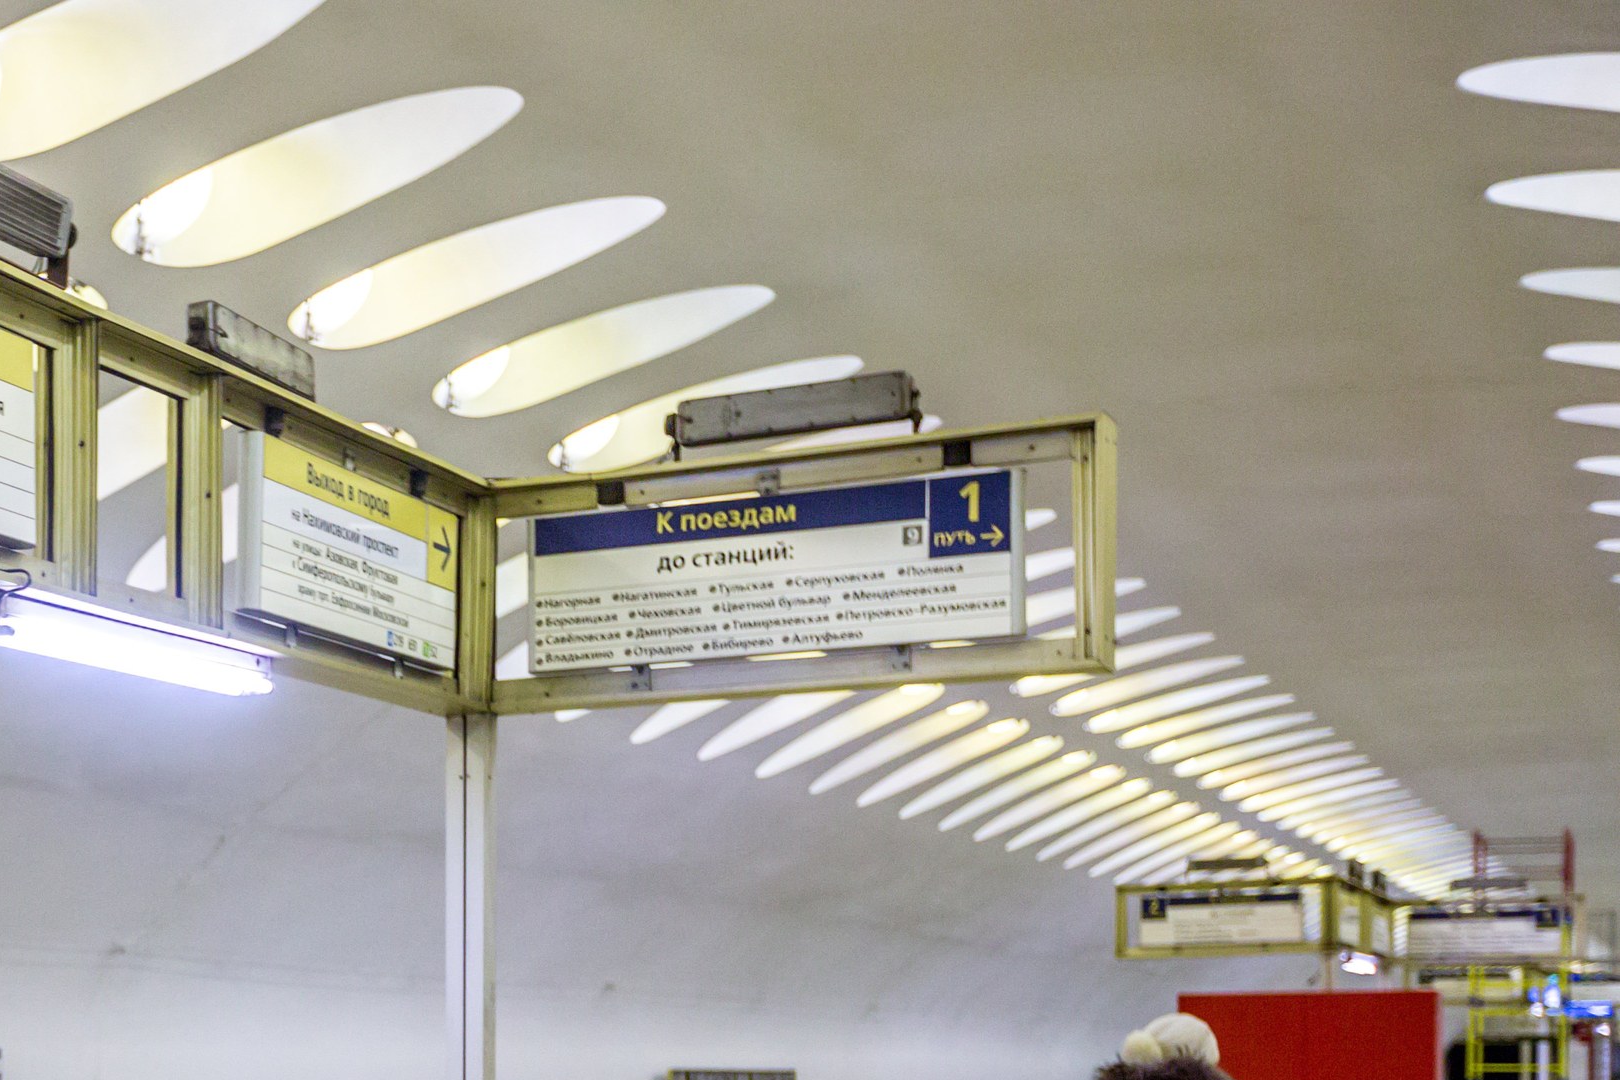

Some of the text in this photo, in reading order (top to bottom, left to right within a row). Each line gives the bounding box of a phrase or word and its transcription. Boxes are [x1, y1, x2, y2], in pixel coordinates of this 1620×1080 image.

[307, 461, 391, 520] Выход в город
[959, 480, 980, 523] 1
[656, 504, 797, 534] К поездам
[656, 541, 795, 573] до станций:
[544, 563, 964, 611] Нагорная Нагатинская Тульская Серпуховская Полянка
[545, 583, 957, 629] Боровицкая Чеховская Цветной бульвар Менделеевская
[545, 628, 864, 665] Владыкино Отрадное Бибирево Алтуфьево
[635, 622, 717, 640] Дмитровская
[732, 614, 830, 635] Тимирязевская
